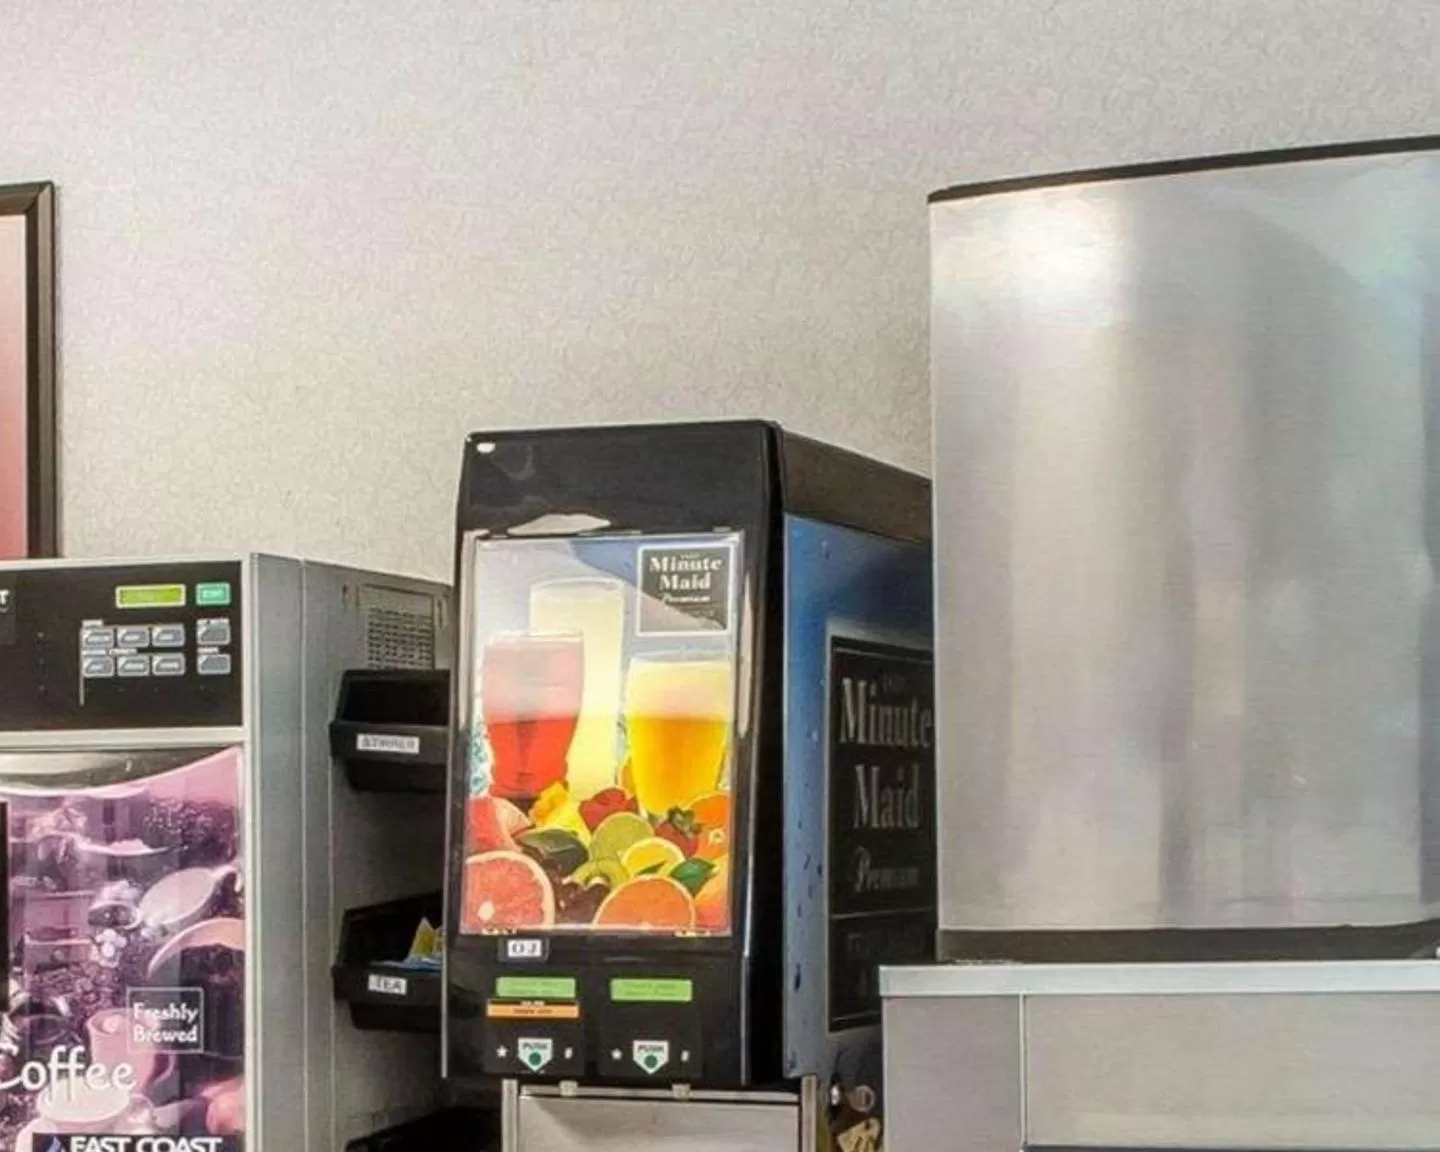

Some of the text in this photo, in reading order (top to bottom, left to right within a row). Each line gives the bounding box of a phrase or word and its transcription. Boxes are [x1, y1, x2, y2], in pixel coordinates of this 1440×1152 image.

[649, 555, 724, 574] Minute
[659, 572, 712, 590] Maid
[839, 676, 932, 748] Minute
[853, 763, 920, 829] Maid
[132, 1001, 199, 1022] Freshly
[133, 1026, 198, 1044] Brewed
